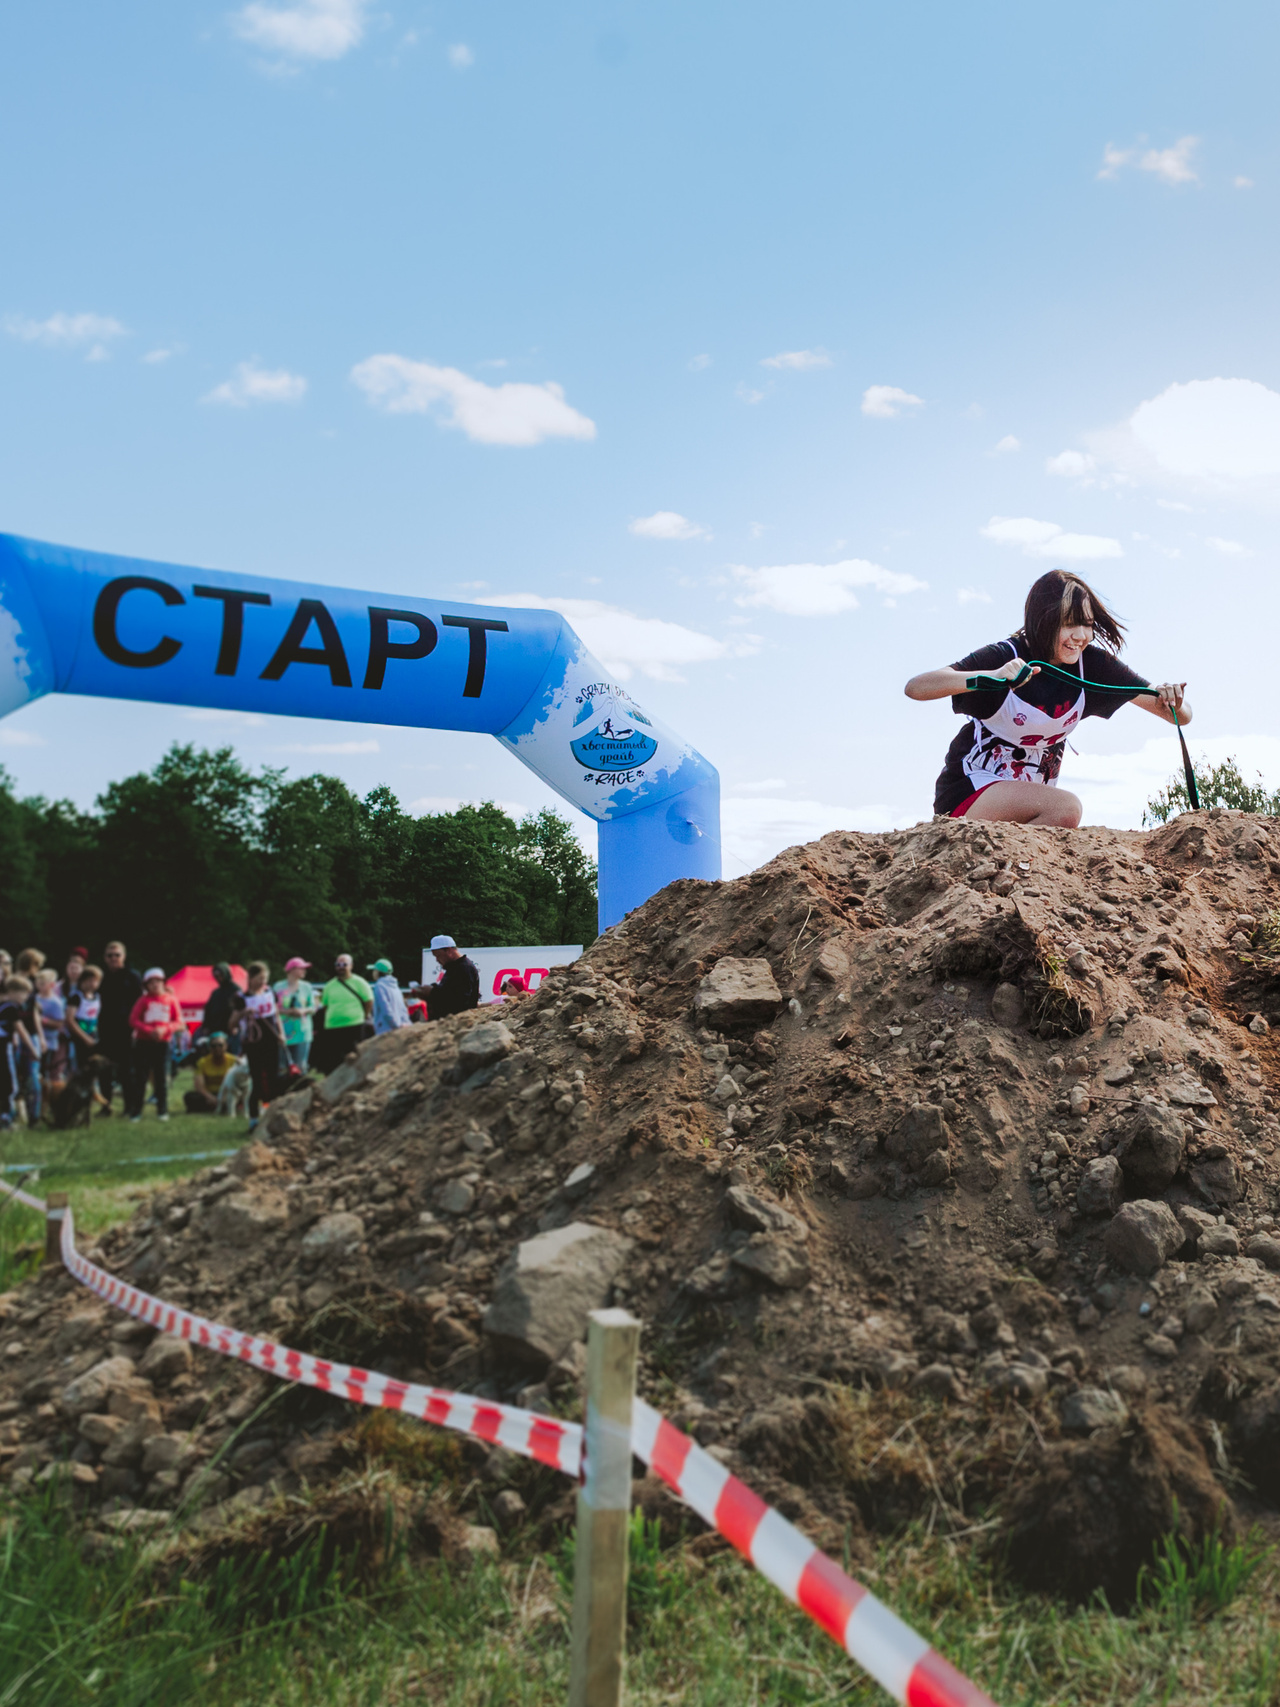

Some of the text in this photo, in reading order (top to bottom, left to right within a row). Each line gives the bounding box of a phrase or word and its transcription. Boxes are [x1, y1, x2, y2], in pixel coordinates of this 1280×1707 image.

[92, 575, 510, 698] СТАРТ
[580, 682, 611, 700] CRAZY
[599, 750, 635, 767] драйв
[595, 771, 636, 786] RACE
